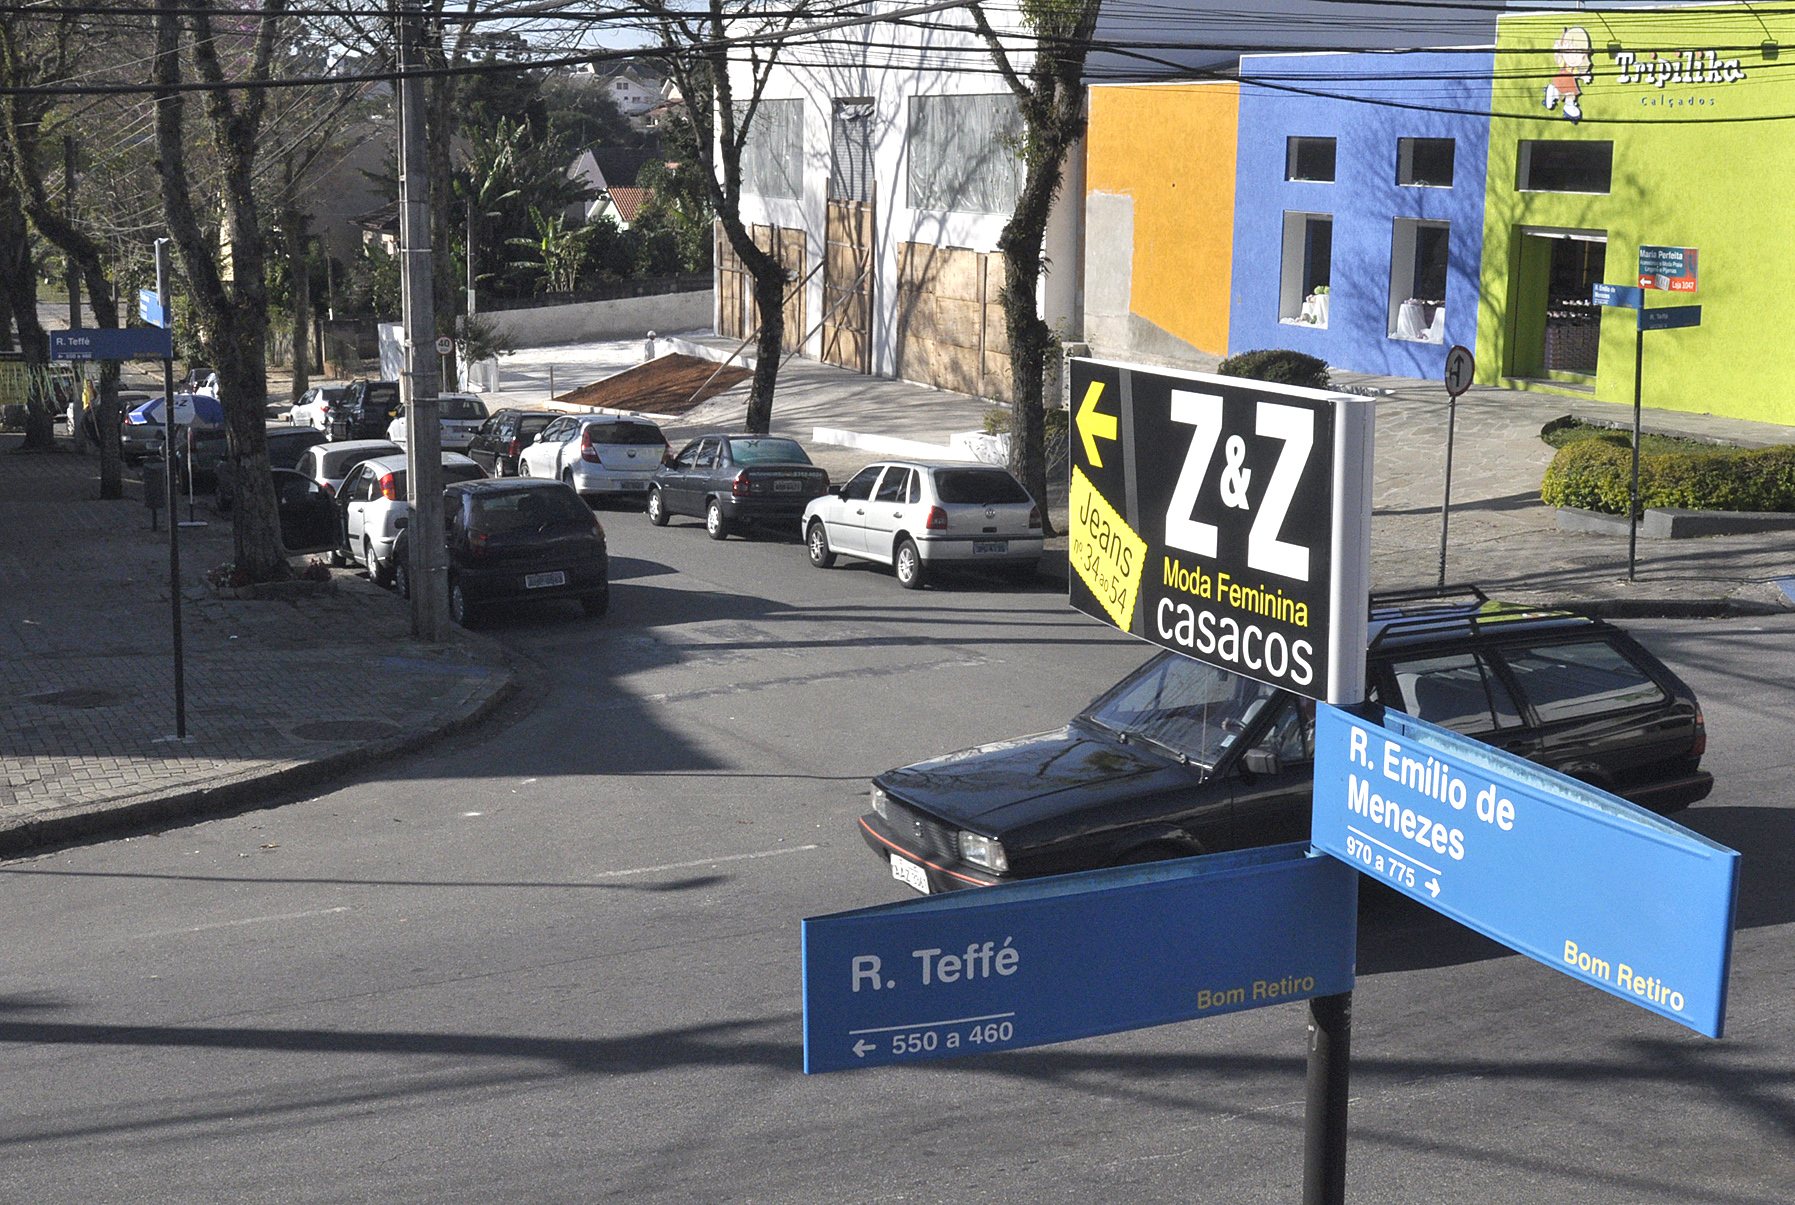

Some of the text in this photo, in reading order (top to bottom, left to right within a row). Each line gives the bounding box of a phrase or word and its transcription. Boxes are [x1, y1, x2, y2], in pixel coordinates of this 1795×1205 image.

[1615, 50, 1745, 87] Tripilika
[1641, 94, 1715, 107] Calçados
[1640, 249, 1683, 260] Maria Perfeita
[1672, 281, 1694, 289] Loja 1047
[56, 336, 90, 345] R. Teffé
[438, 339, 450, 347] 40
[1080, 491, 1133, 578] Jeans
[1099, 571, 1109, 594] ao
[1109, 575, 1127, 615] 54
[1163, 556, 1308, 628] Moda Feminina
[1157, 597, 1314, 686] casacos
[1350, 726, 1516, 831] R. Emílio de
[1347, 774, 1465, 861] Menezes
[1346, 835, 1415, 888] 970 a 775
[851, 936, 1020, 993] R. Teffé
[1563, 940, 1685, 1012] Bom Retiro
[1196, 974, 1315, 1011] Bom Retiro
[892, 1021, 1014, 1056] 550 a 460
